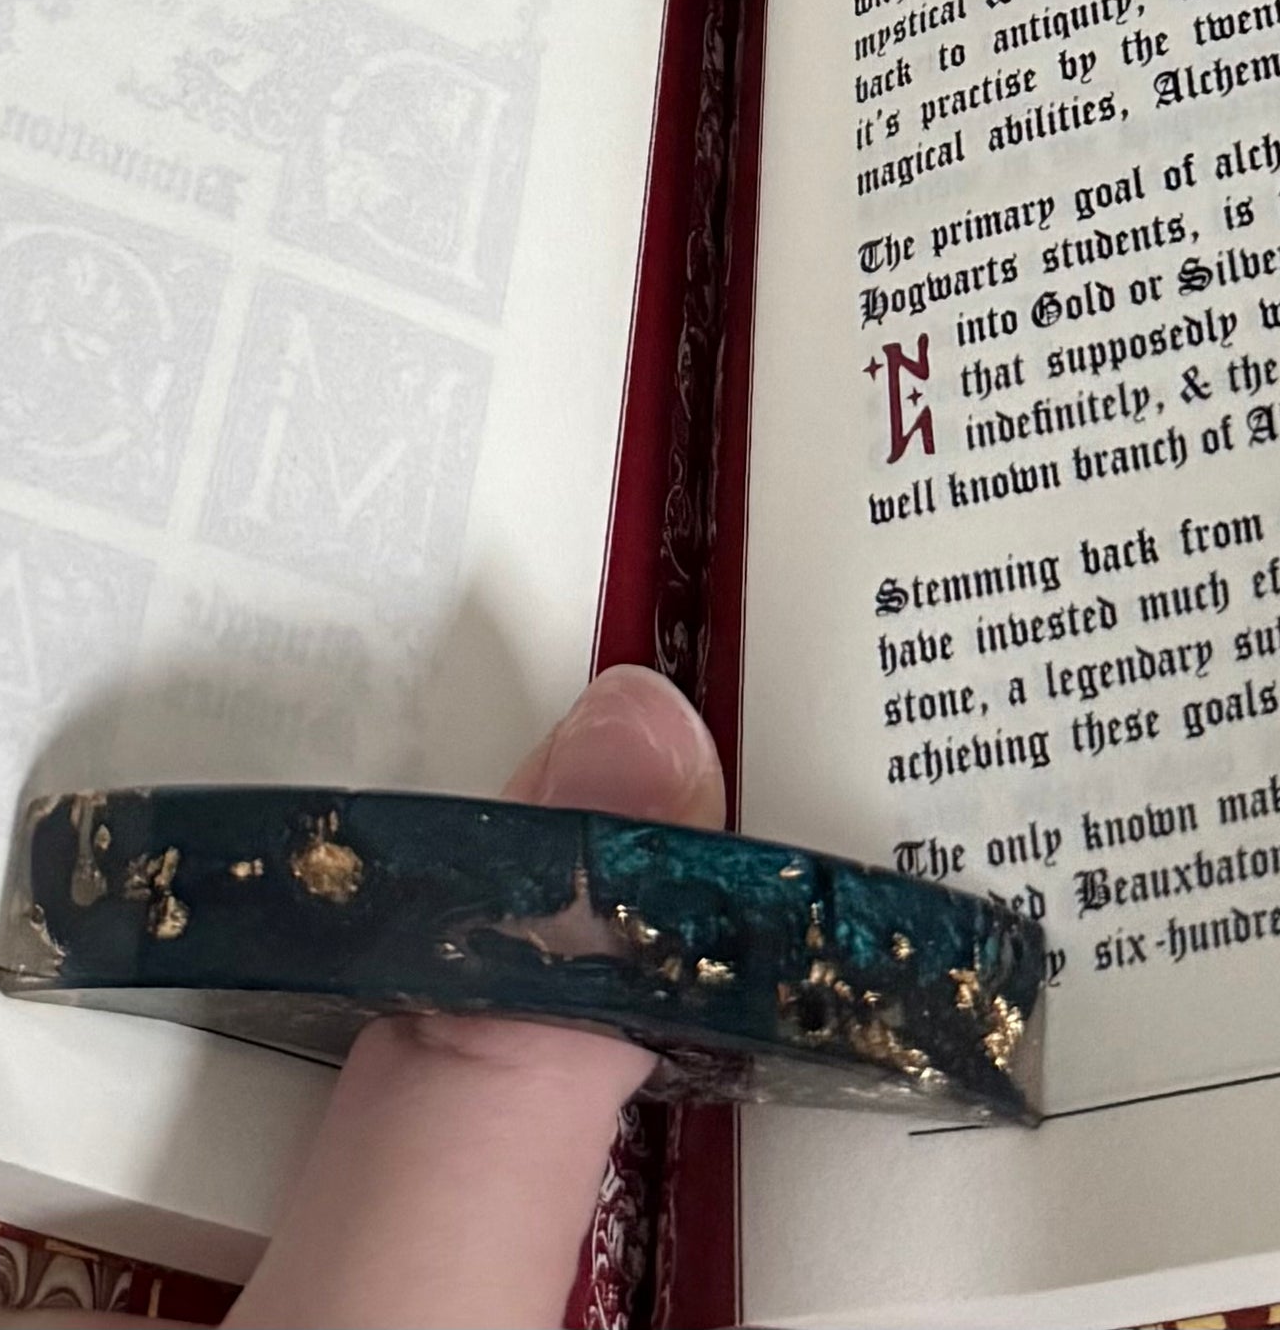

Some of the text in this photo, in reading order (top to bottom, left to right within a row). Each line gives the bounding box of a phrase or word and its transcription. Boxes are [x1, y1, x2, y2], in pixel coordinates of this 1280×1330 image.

[920, 68, 1038, 131] practise
[1057, 49, 1097, 85] by
[1120, 28, 1170, 68] the
[857, 233, 915, 275] The
[930, 196, 1056, 258] primary
[1074, 164, 1146, 222] goal
[1163, 152, 1198, 192] of
[868, 476, 937, 526] well
[947, 460, 1062, 509] known
[1071, 425, 1188, 483] branch
[1200, 413, 1235, 456] of
[877, 629, 955, 678] have
[976, 595, 1118, 655] invested
[1137, 570, 1230, 624] much
[884, 685, 989, 727] stone,
[1007, 676, 1028, 707] a
[1045, 639, 1214, 702] legendary
[892, 837, 967, 881] The
[986, 821, 1062, 868] only
[1081, 803, 1199, 852] known
